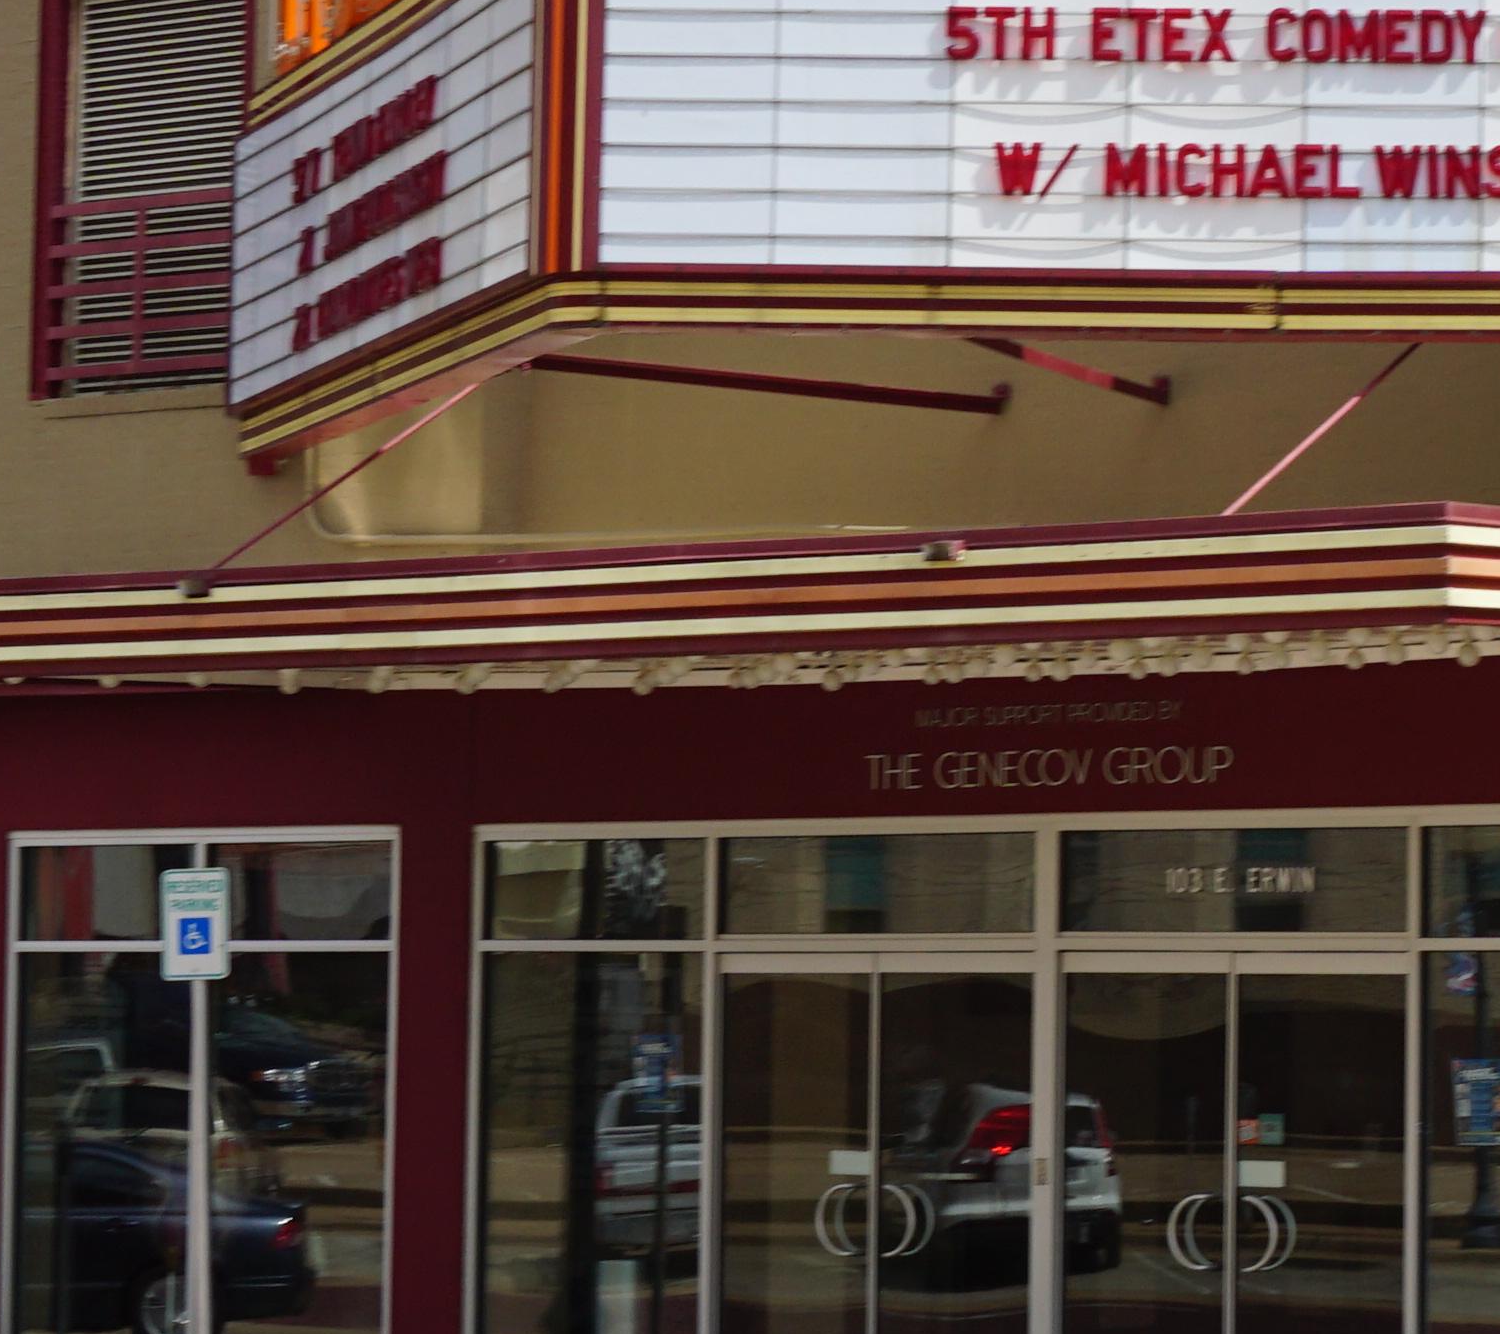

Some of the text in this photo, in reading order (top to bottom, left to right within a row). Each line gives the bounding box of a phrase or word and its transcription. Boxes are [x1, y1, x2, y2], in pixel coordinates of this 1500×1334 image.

[944, 6, 1056, 61] 5TH
[1090, 7, 1234, 63] ETEX
[1264, 8, 1486, 64] COMEDY
[994, 141, 1080, 198] W/
[1105, 142, 1362, 199] MICHAEL
[914, 700, 1182, 728] MAJOR SUPPORT PROVIDED BY
[863, 746, 1234, 790] THE GENECOV GROUP
[1165, 867, 1203, 893] 103
[1246, 867, 1315, 893] ERWIN
